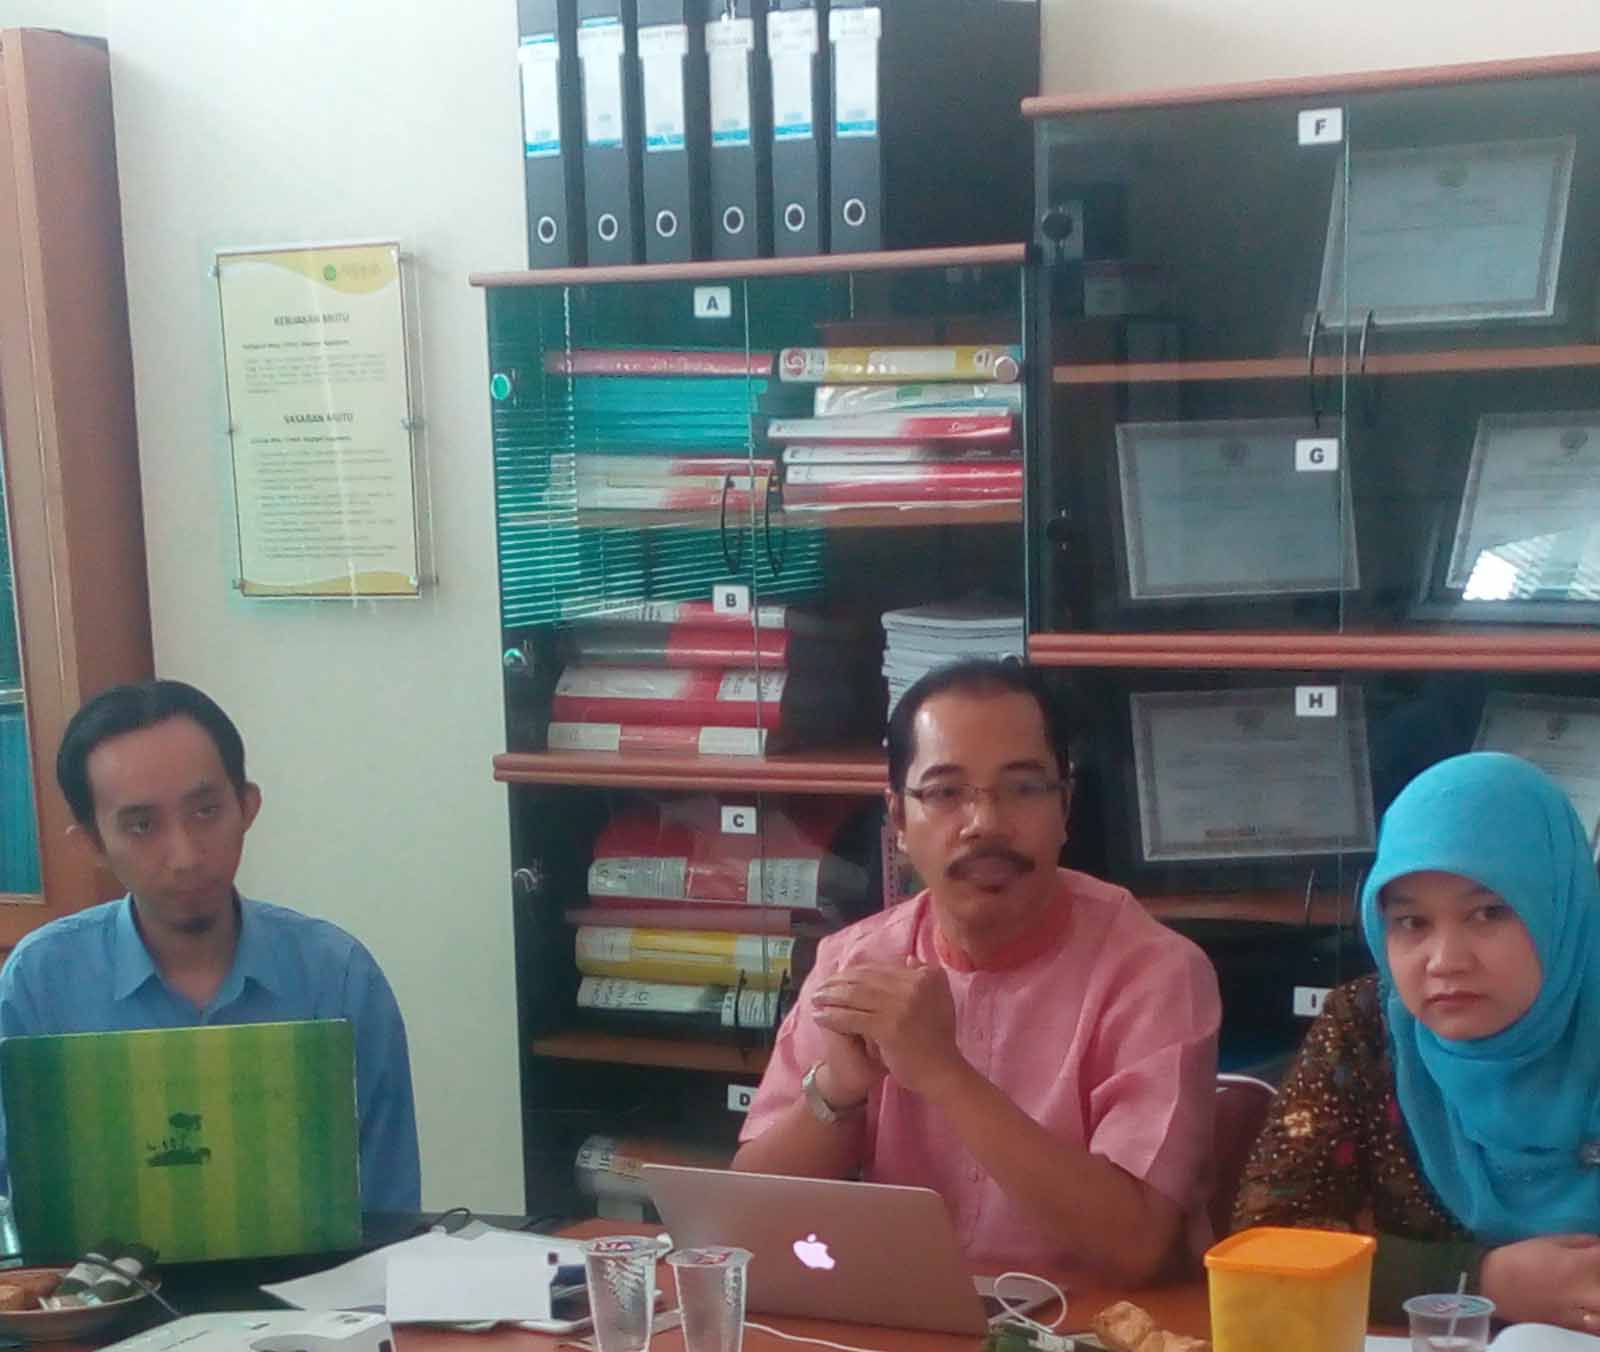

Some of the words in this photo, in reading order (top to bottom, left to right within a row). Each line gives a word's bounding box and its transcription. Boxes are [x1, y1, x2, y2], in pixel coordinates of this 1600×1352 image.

[1314, 118, 1327, 136] F
[706, 295, 719, 311] A
[1309, 447, 1325, 465] G
[725, 592, 737, 608] B
[1308, 692, 1324, 709] H
[732, 813, 745, 828] C
[739, 1092, 751, 1107] D
